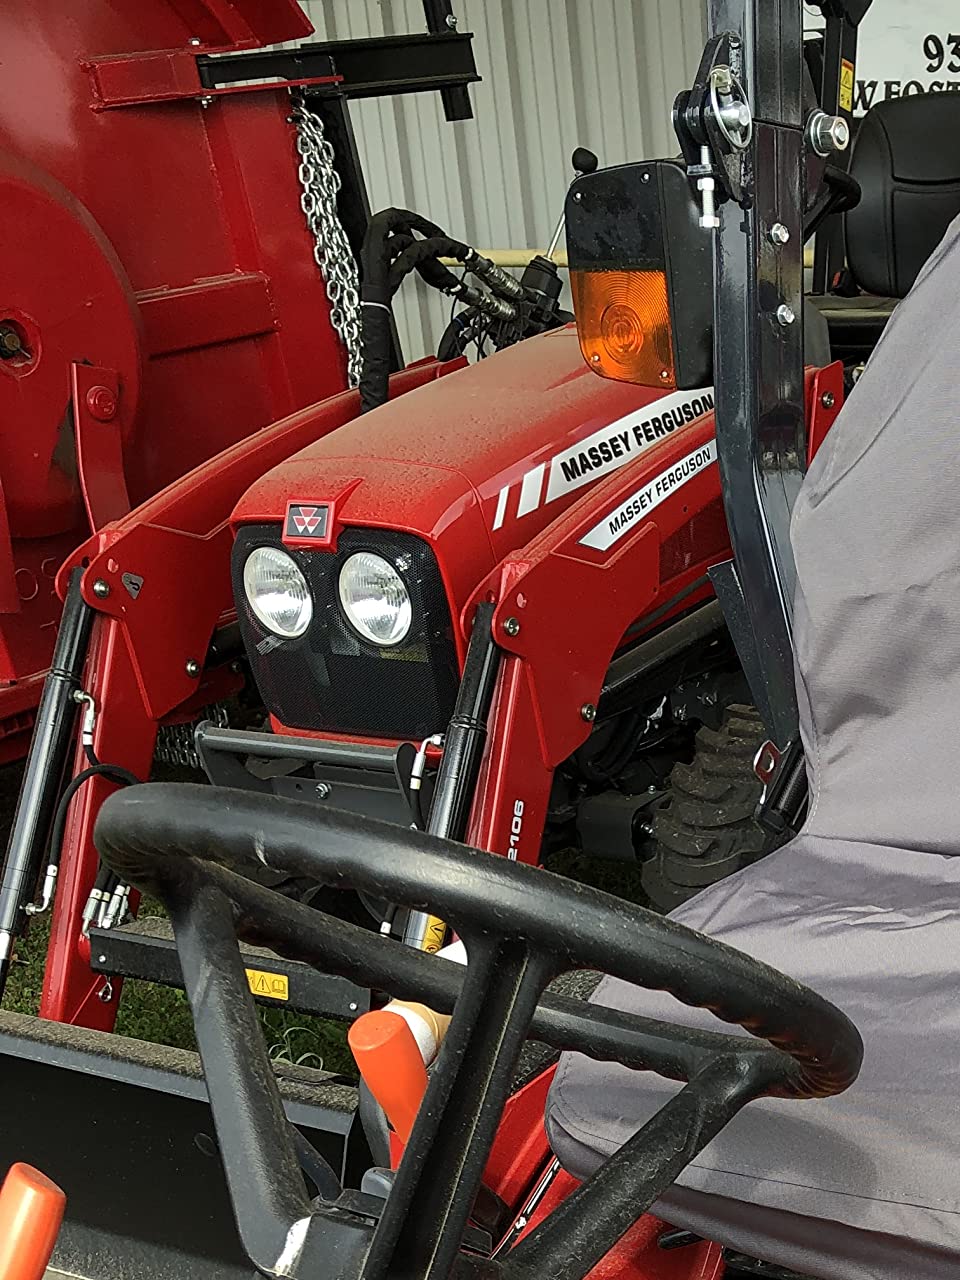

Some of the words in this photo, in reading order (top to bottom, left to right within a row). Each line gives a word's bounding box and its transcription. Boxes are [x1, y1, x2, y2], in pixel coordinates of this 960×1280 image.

[560, 431, 632, 482] MASSEY
[632, 393, 714, 446] FERGUSON
[608, 488, 653, 535] MASSEY
[655, 448, 711, 497] FERGUSON
